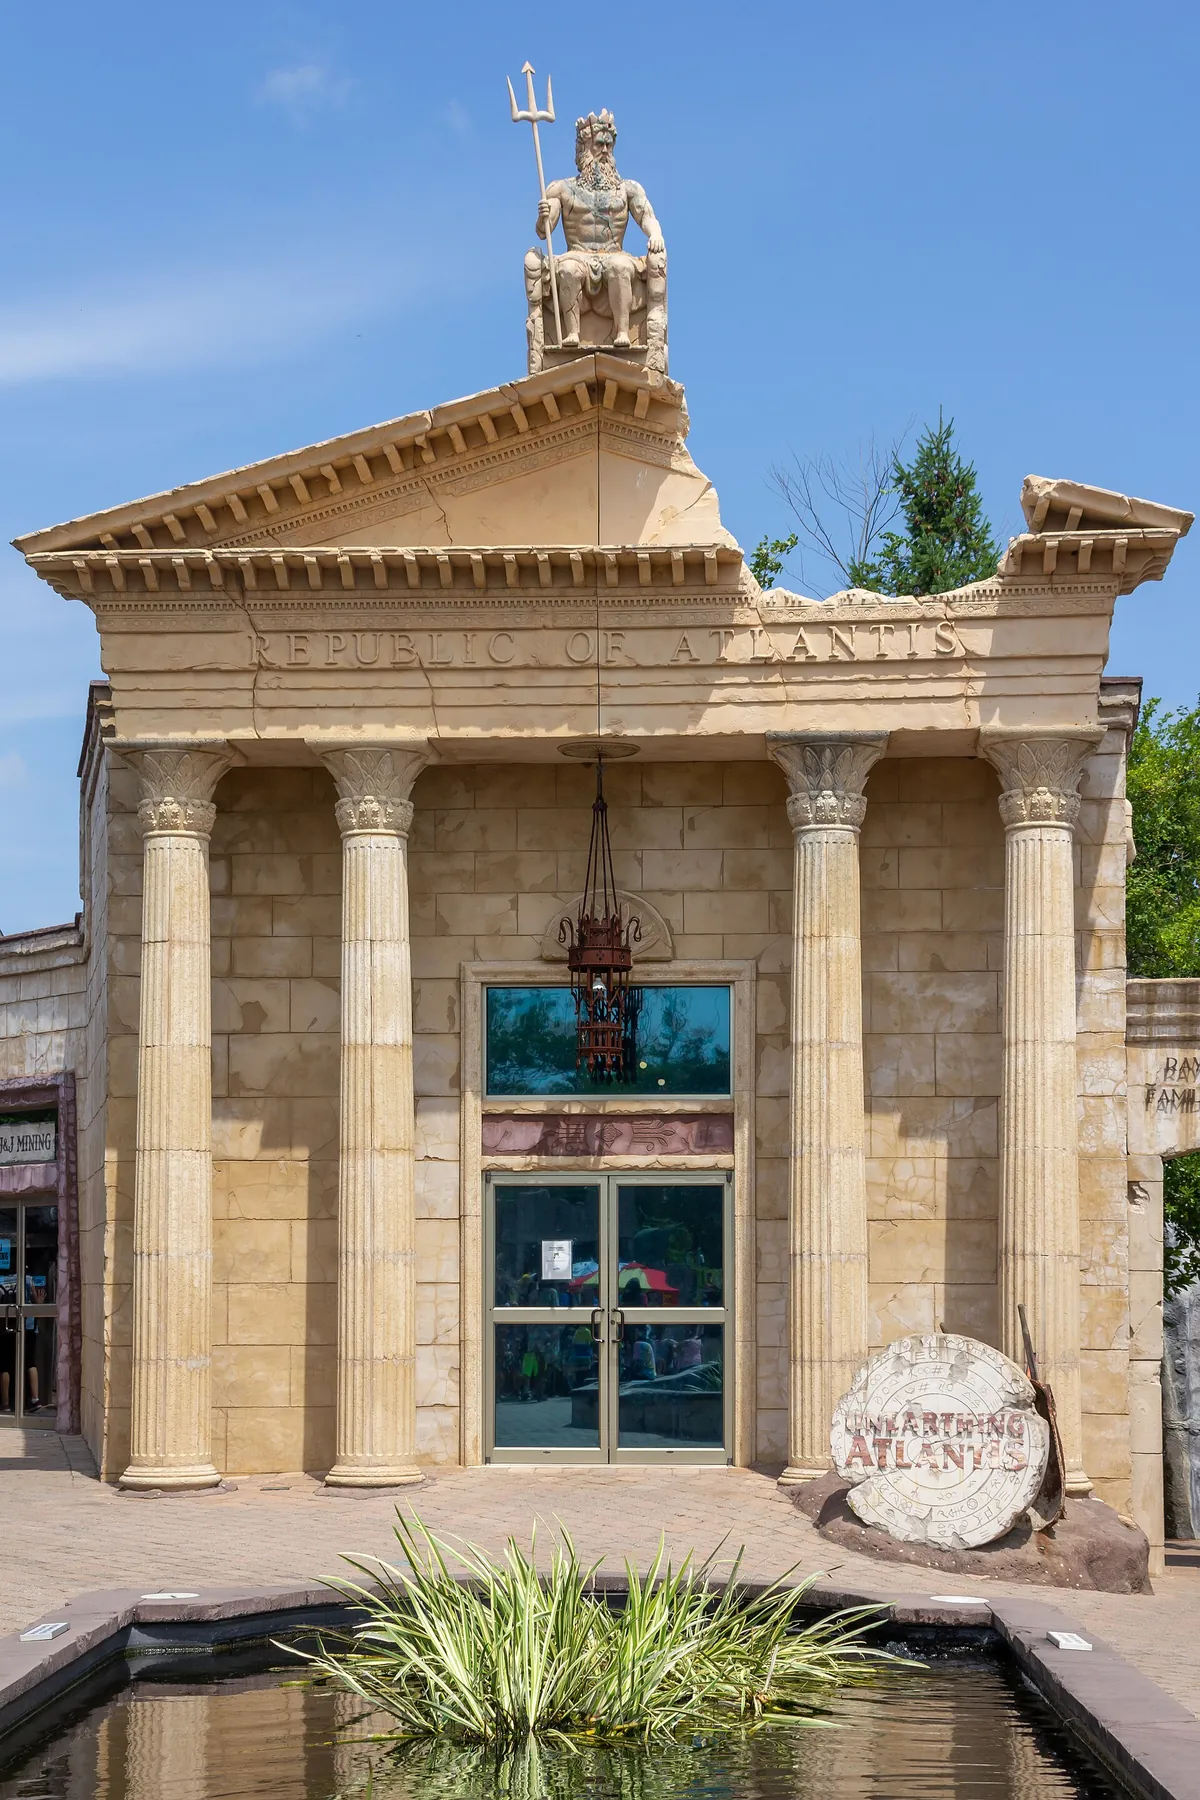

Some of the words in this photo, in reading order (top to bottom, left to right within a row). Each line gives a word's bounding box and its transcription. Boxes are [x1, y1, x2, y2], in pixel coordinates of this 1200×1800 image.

[247, 632, 516, 666] REPUBLIC
[565, 630, 626, 665] OF
[670, 621, 957, 663] ATLANTIS
[17, 1133, 51, 1152] MINING
[845, 1412, 1025, 1438] UNEARTHING
[845, 1435, 1027, 1471] ATLANTIS
